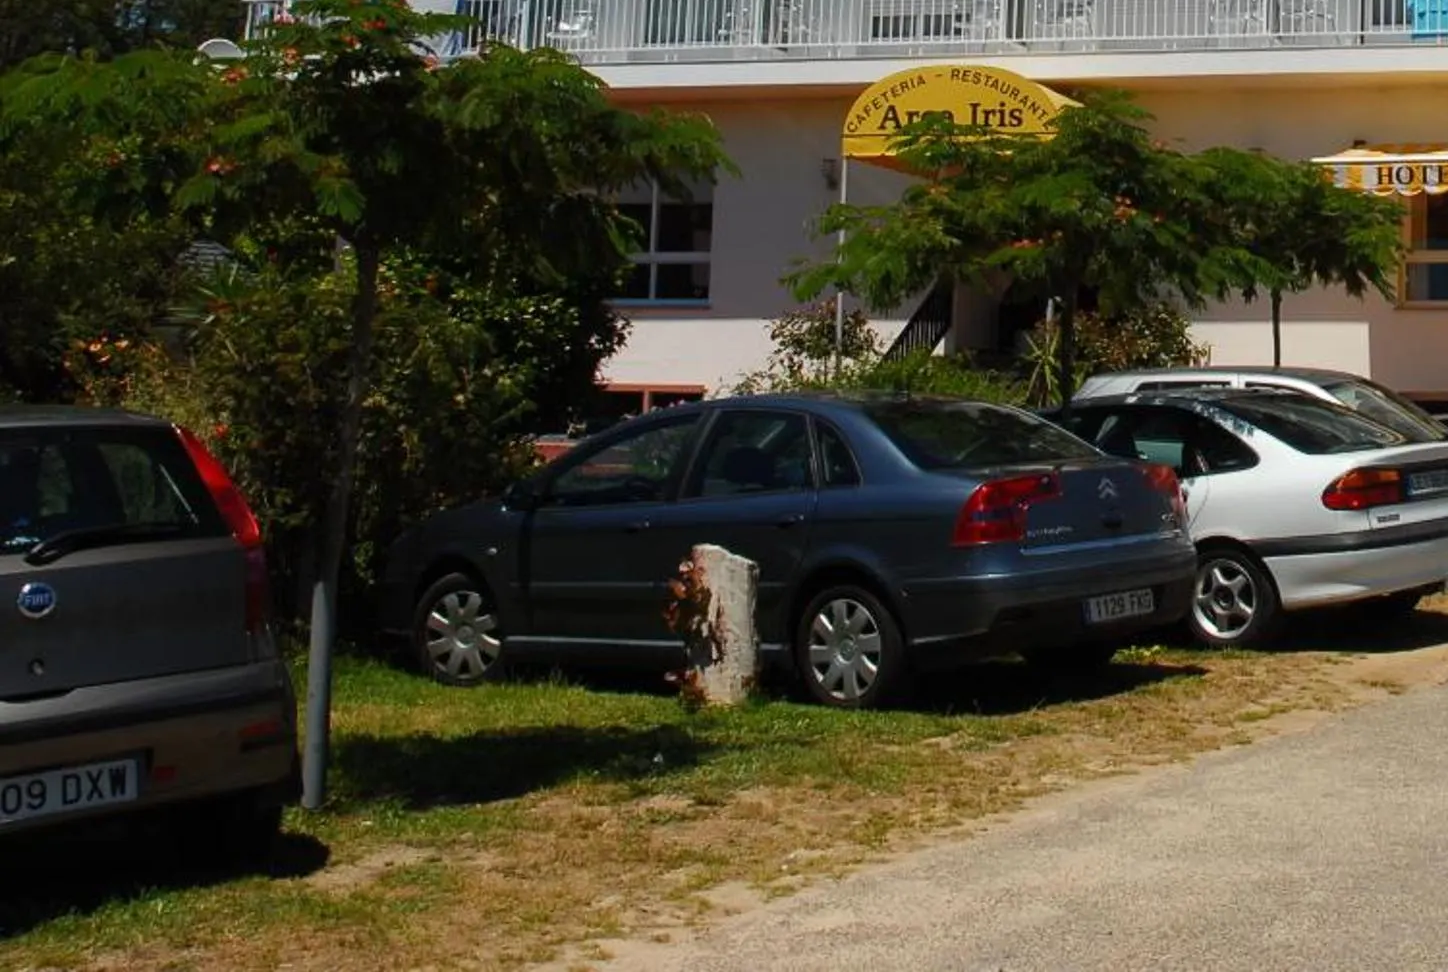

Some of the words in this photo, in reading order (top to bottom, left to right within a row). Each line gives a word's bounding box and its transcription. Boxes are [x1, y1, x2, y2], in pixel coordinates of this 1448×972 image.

[847, 74, 926, 133] CAFETERIA
[950, 68, 1051, 132] RESTAURANTE
[877, 104, 955, 130] Aro
[968, 101, 1024, 128] Iris
[62, 765, 127, 805] DXW
